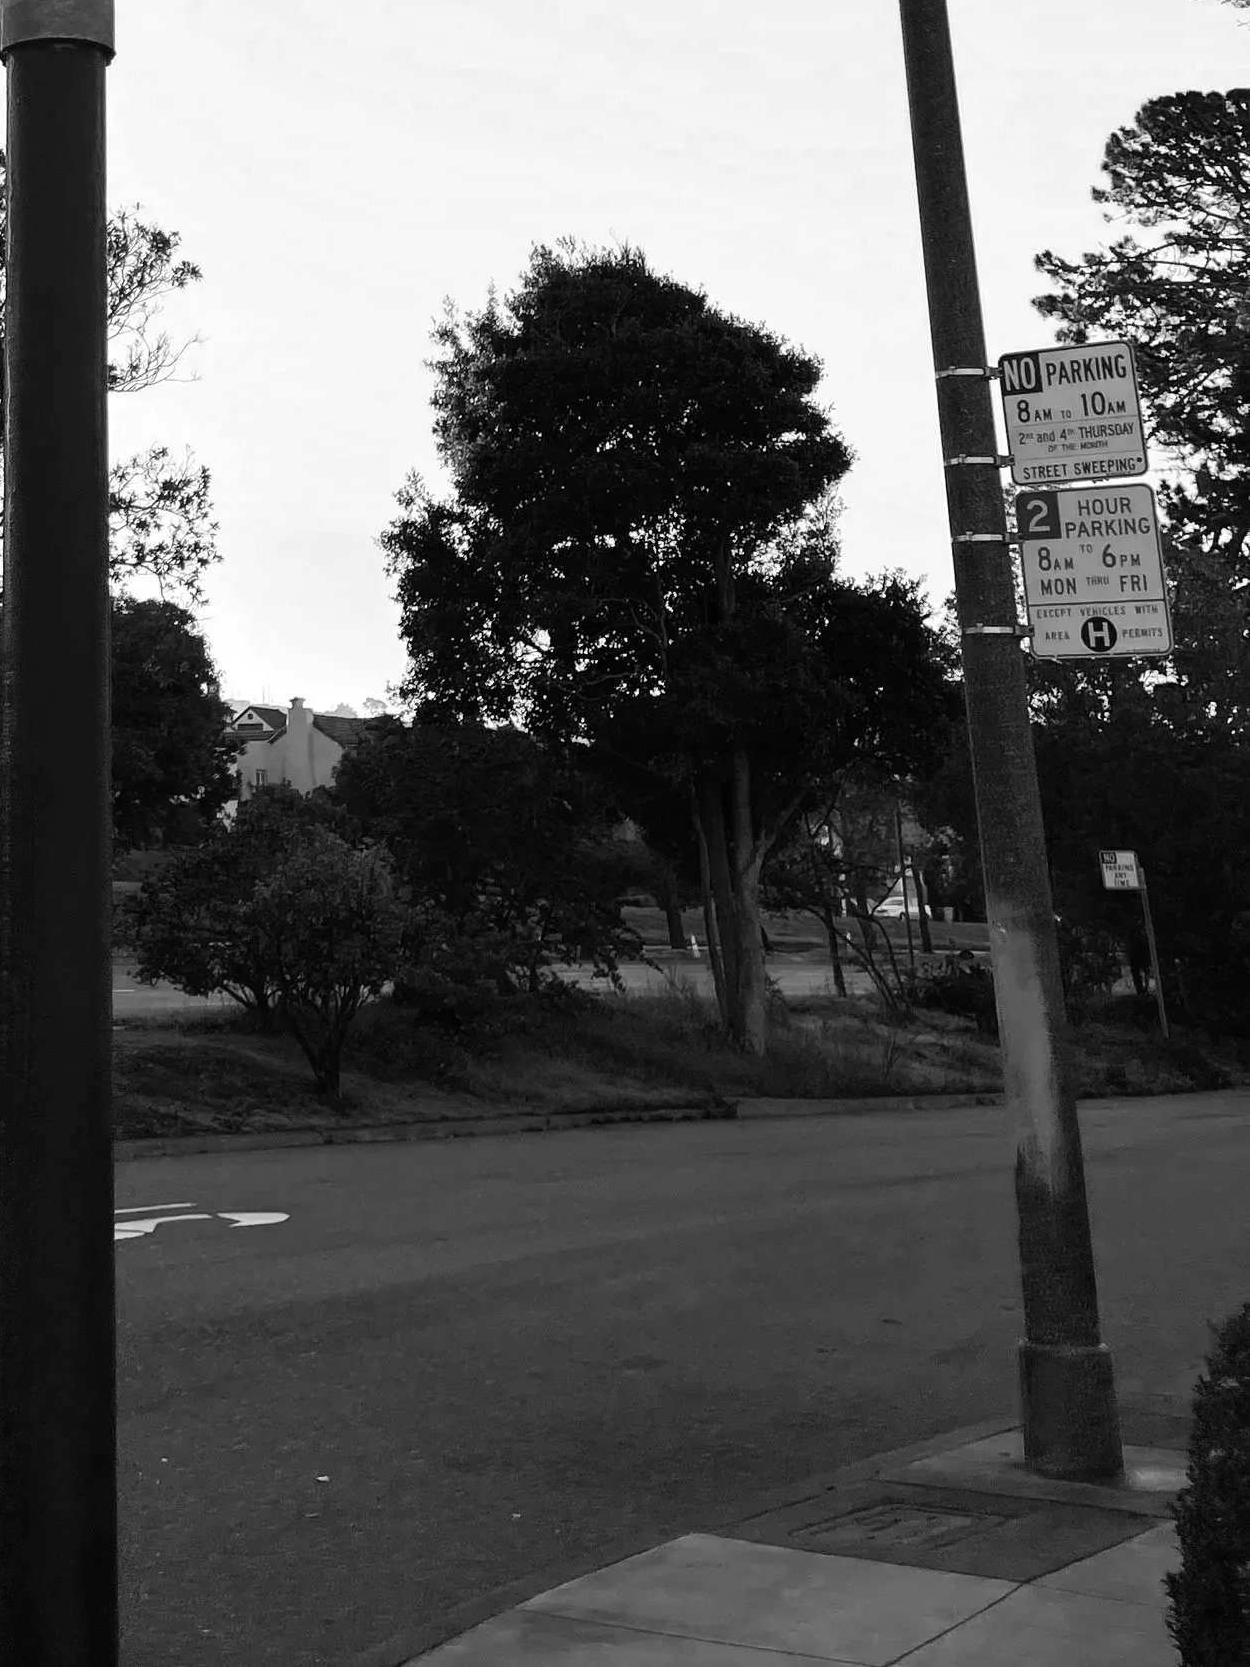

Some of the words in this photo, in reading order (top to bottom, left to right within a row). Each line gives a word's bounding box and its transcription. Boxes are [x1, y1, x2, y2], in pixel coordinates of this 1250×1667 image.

[1003, 357, 1036, 391] NO
[1046, 354, 1127, 386] PARKING
[1061, 409, 1072, 419] TO
[1037, 432, 1055, 443] and
[1078, 422, 1135, 439] THURSDAY
[1048, 444, 1058, 453] OF
[1062, 443, 1078, 451] THE
[1080, 440, 1108, 450] MONTH
[1023, 464, 1068, 480] STREET
[1074, 457, 1136, 476] SWEEPING
[1026, 499, 1051, 532] 2
[1078, 497, 1132, 516] HOUR
[1065, 517, 1150, 539] PARKING
[1080, 544, 1093, 554] TO
[1040, 577, 1077, 596] MON
[1086, 576, 1110, 586] THRU
[1119, 574, 1148, 593] FRI
[1036, 608, 1072, 619] EXCEPT
[1080, 606, 1126, 616] VEHICLES
[1135, 605, 1158, 615] WITH
[1045, 631, 1070, 641] AREA
[1087, 621, 1111, 648] H
[1122, 627, 1163, 639] PERMITS
[1103, 853, 1116, 863] NO
